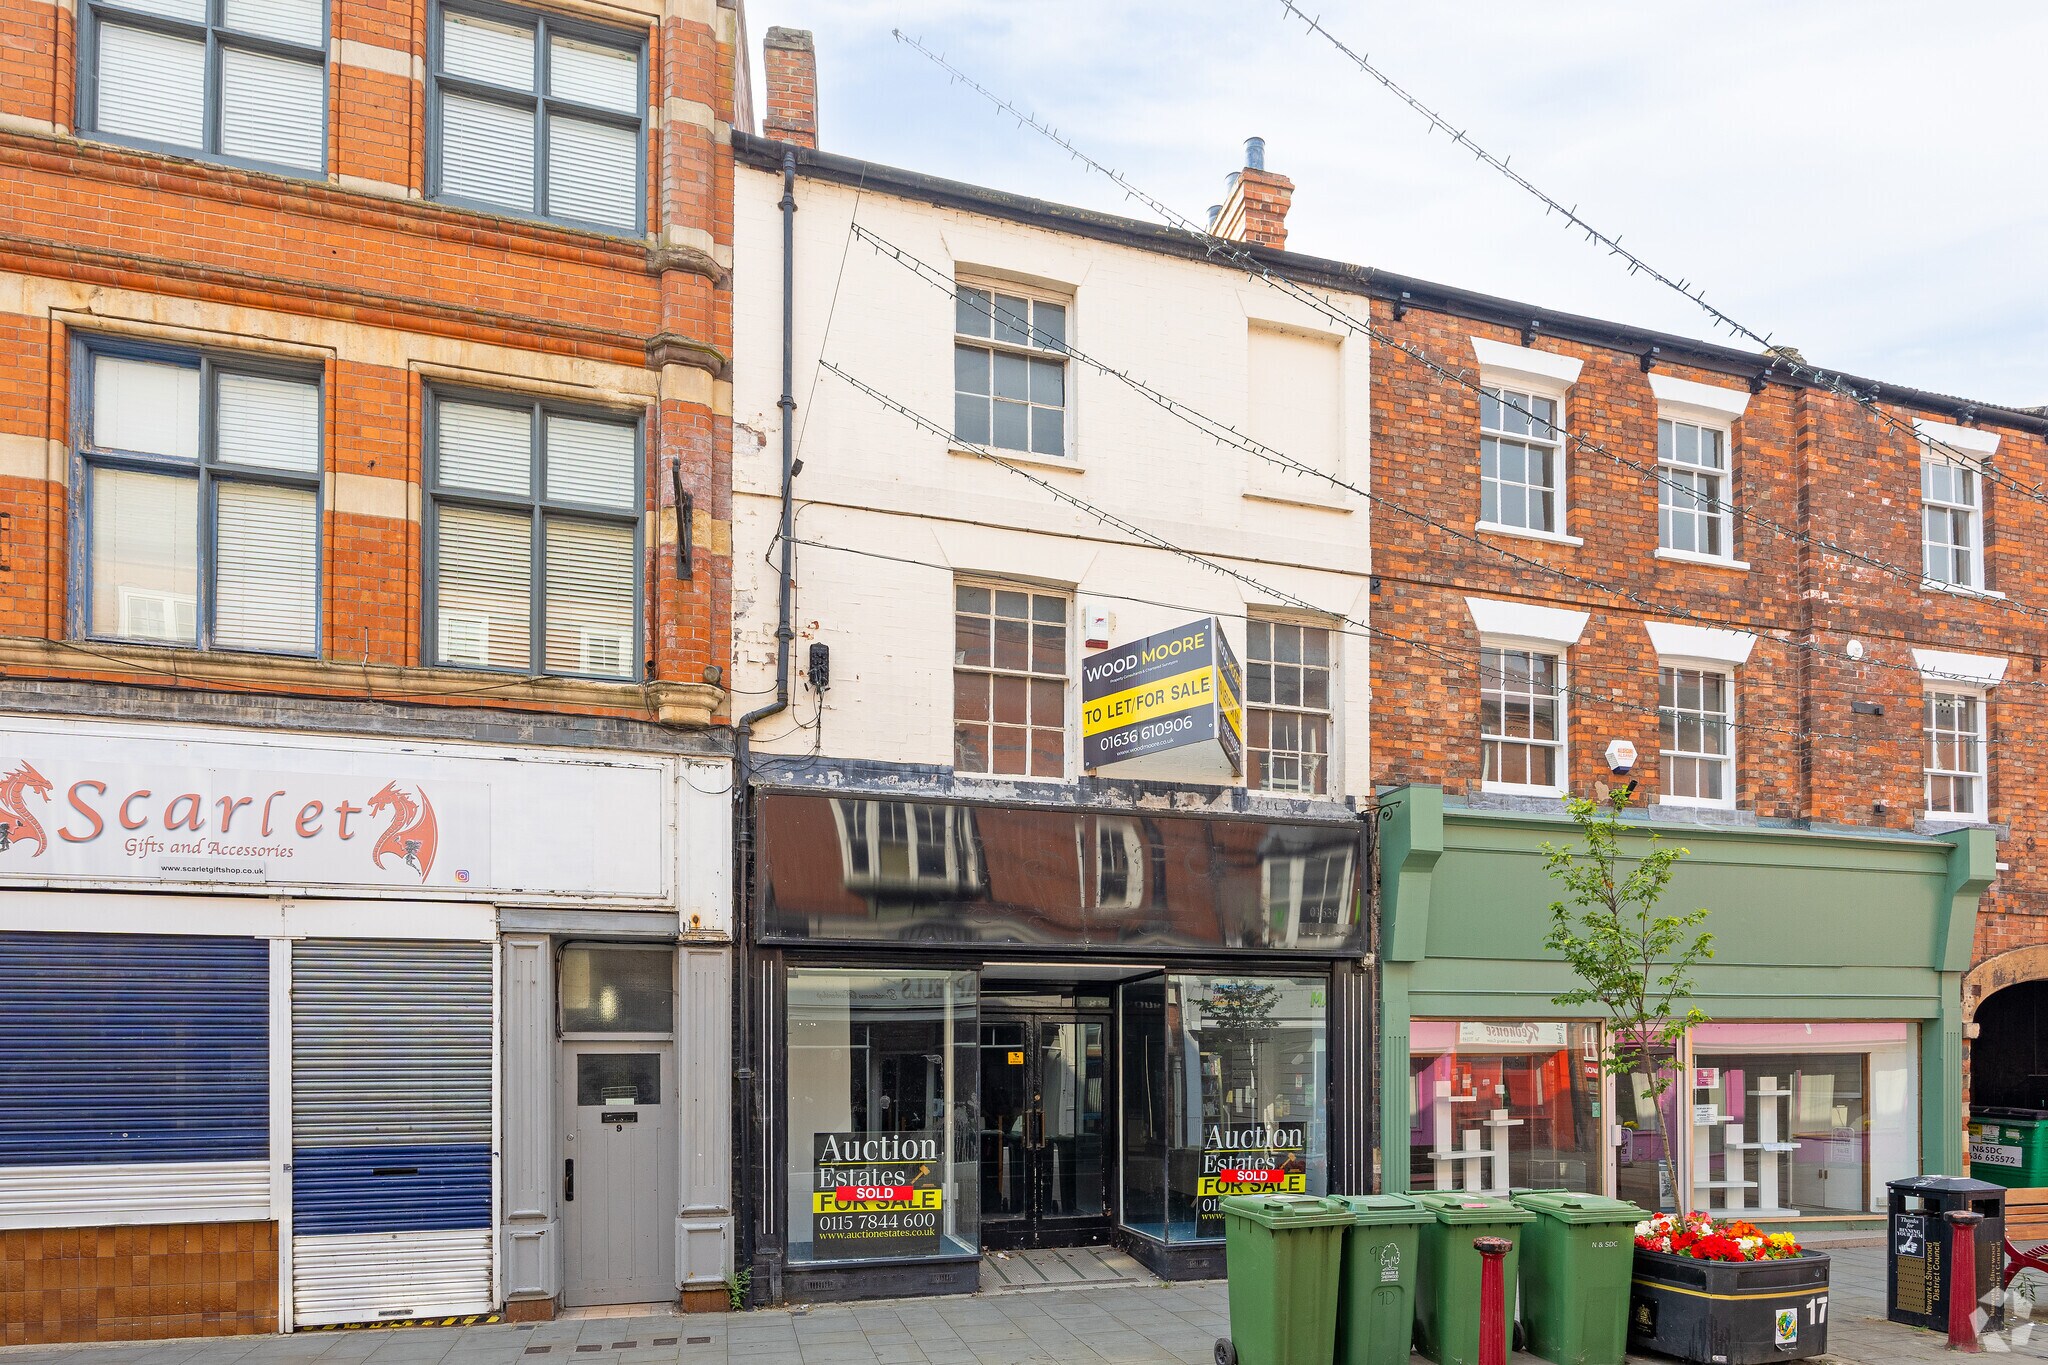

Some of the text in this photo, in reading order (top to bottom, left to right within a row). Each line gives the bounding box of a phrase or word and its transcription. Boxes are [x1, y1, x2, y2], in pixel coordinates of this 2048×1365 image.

[1086, 633, 1205, 682] WOOD MOORE
[1085, 708, 1101, 724] TO
[1107, 690, 1164, 718] LET/FOR
[1171, 677, 1210, 700] SALE
[1100, 716, 1193, 750] 01636 610906
[57, 779, 362, 843] Scarlet
[125, 836, 294, 859] Gifts and Accessories
[161, 865, 264, 875] www.scarletgiftshop.co.uk
[616, 1124, 622, 1132] 9
[1204, 1124, 1303, 1150] Auction
[820, 1134, 937, 1161] Auction
[1972, 1145, 2003, 1155] N&SDC
[1203, 1154, 1275, 1174] Estates
[1985, 1155, 2015, 1164] 655572
[820, 1167, 905, 1188] Estates
[1204, 1176, 1300, 1194] FOR SALE
[1237, 1171, 1268, 1181] SOLD
[820, 1192, 935, 1211] FOR SALE
[856, 1188, 894, 1199] SOLD
[820, 1213, 935, 1231] 0115 7844 600
[820, 1228, 935, 1240] www.auctionestates.co.uk
[1806, 1296, 1828, 1325] 17
